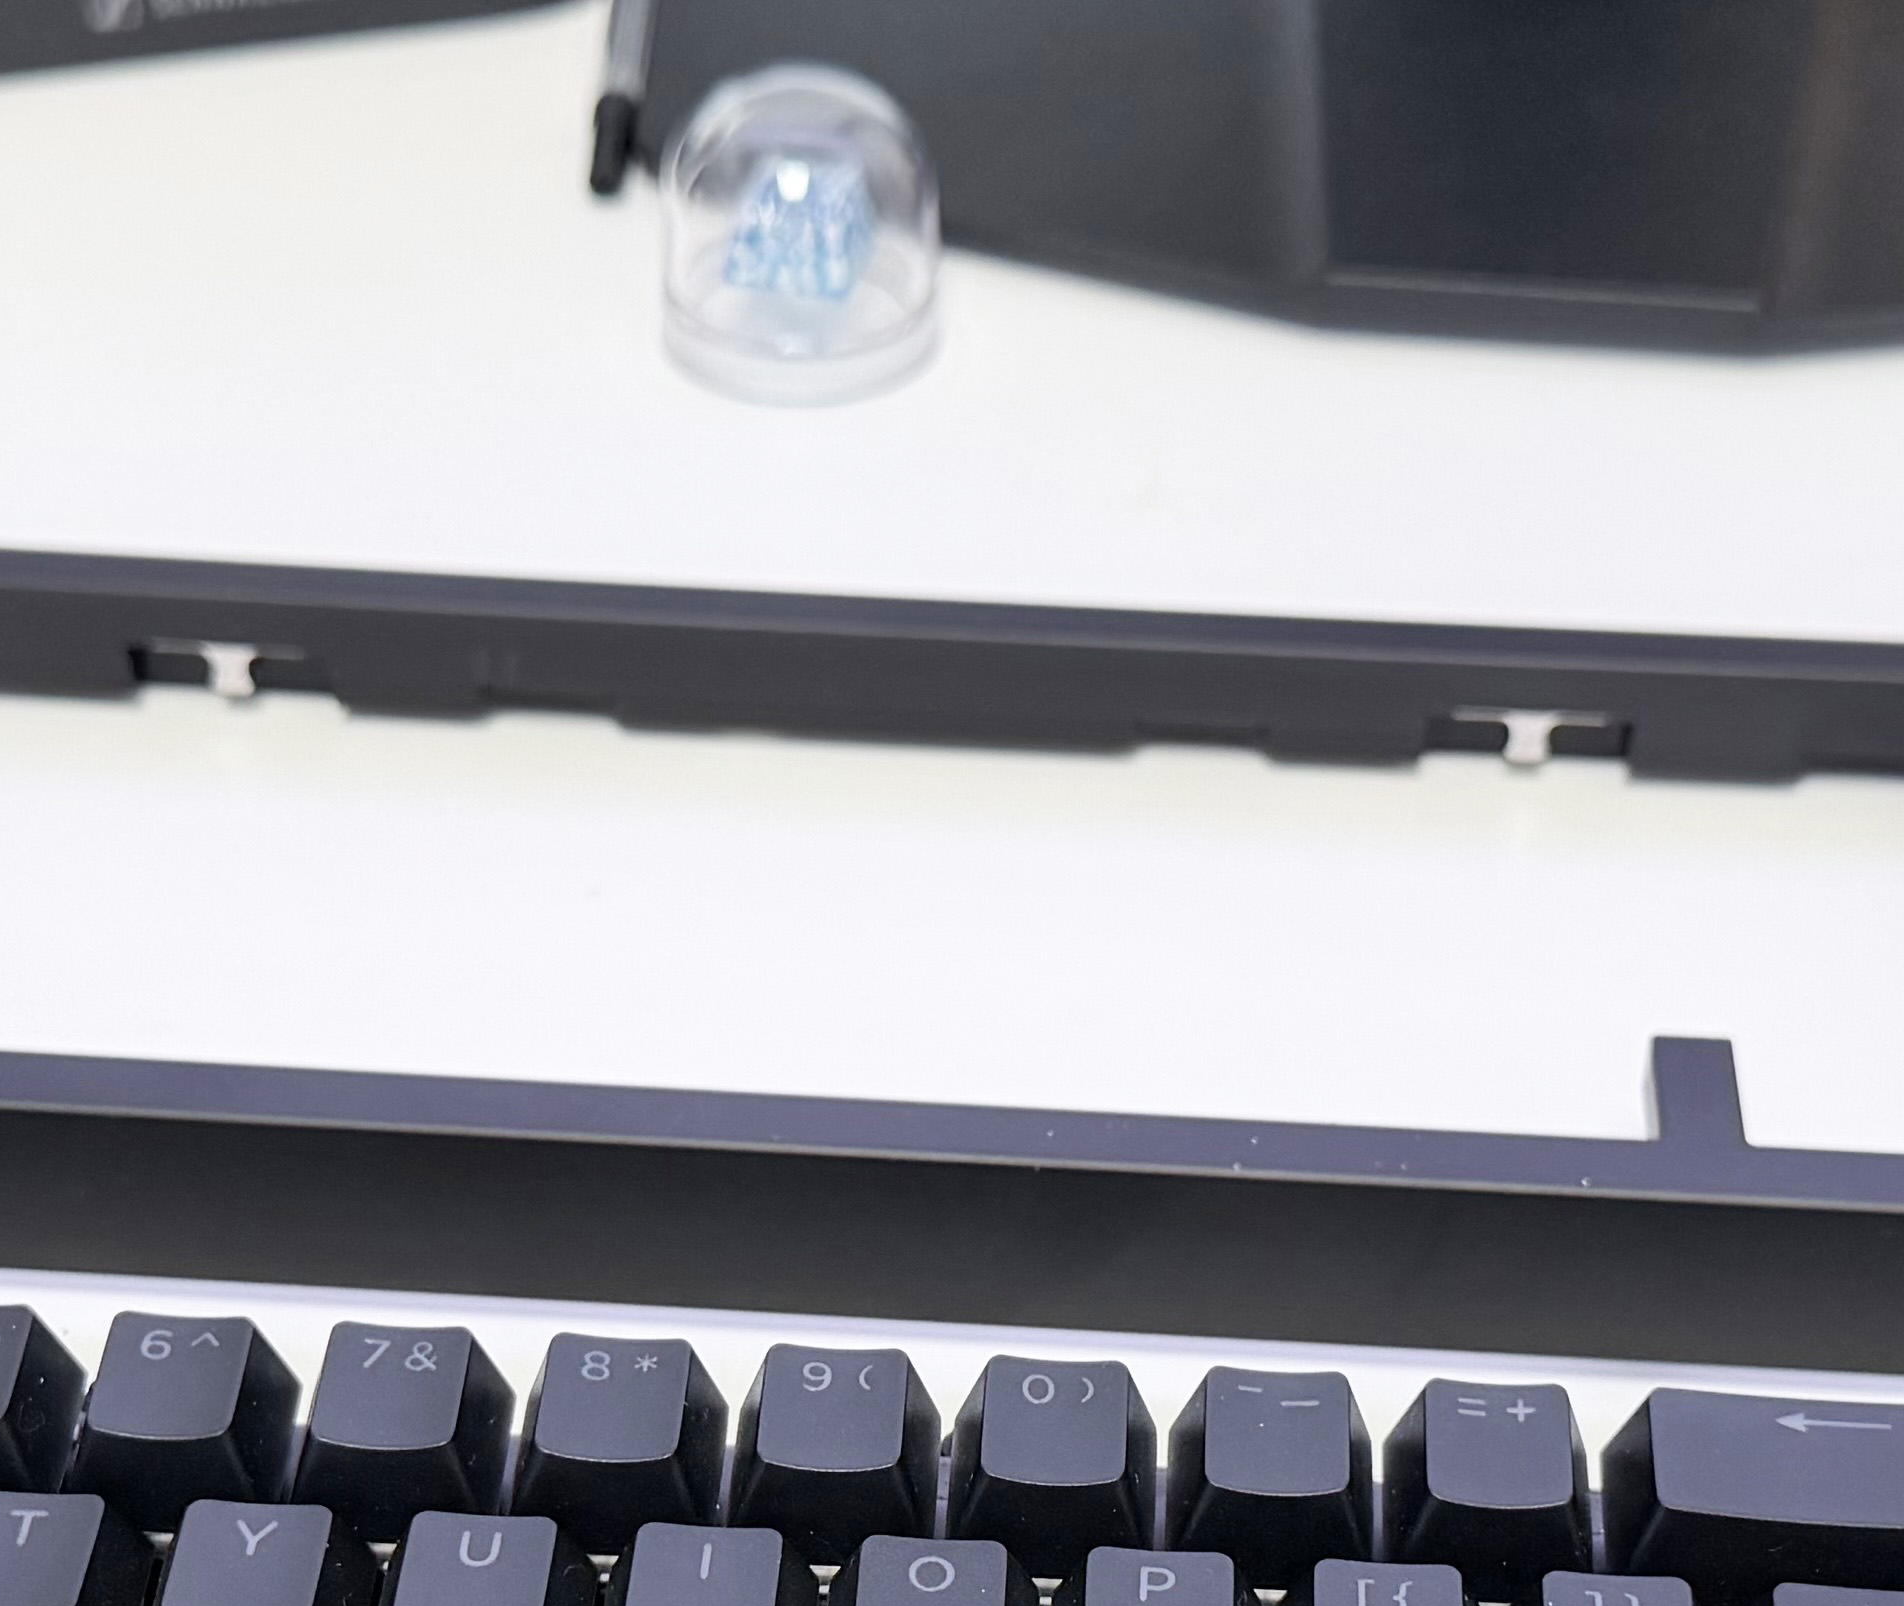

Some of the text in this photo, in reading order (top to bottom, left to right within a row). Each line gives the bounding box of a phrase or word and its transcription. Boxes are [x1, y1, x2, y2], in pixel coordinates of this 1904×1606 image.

[10, 1509, 49, 1547] T
[236, 1519, 279, 1556] Y
[458, 1530, 503, 1568] U
[699, 1542, 713, 1580] I
[908, 1555, 956, 1593] O
[1138, 1565, 1176, 1602] P
